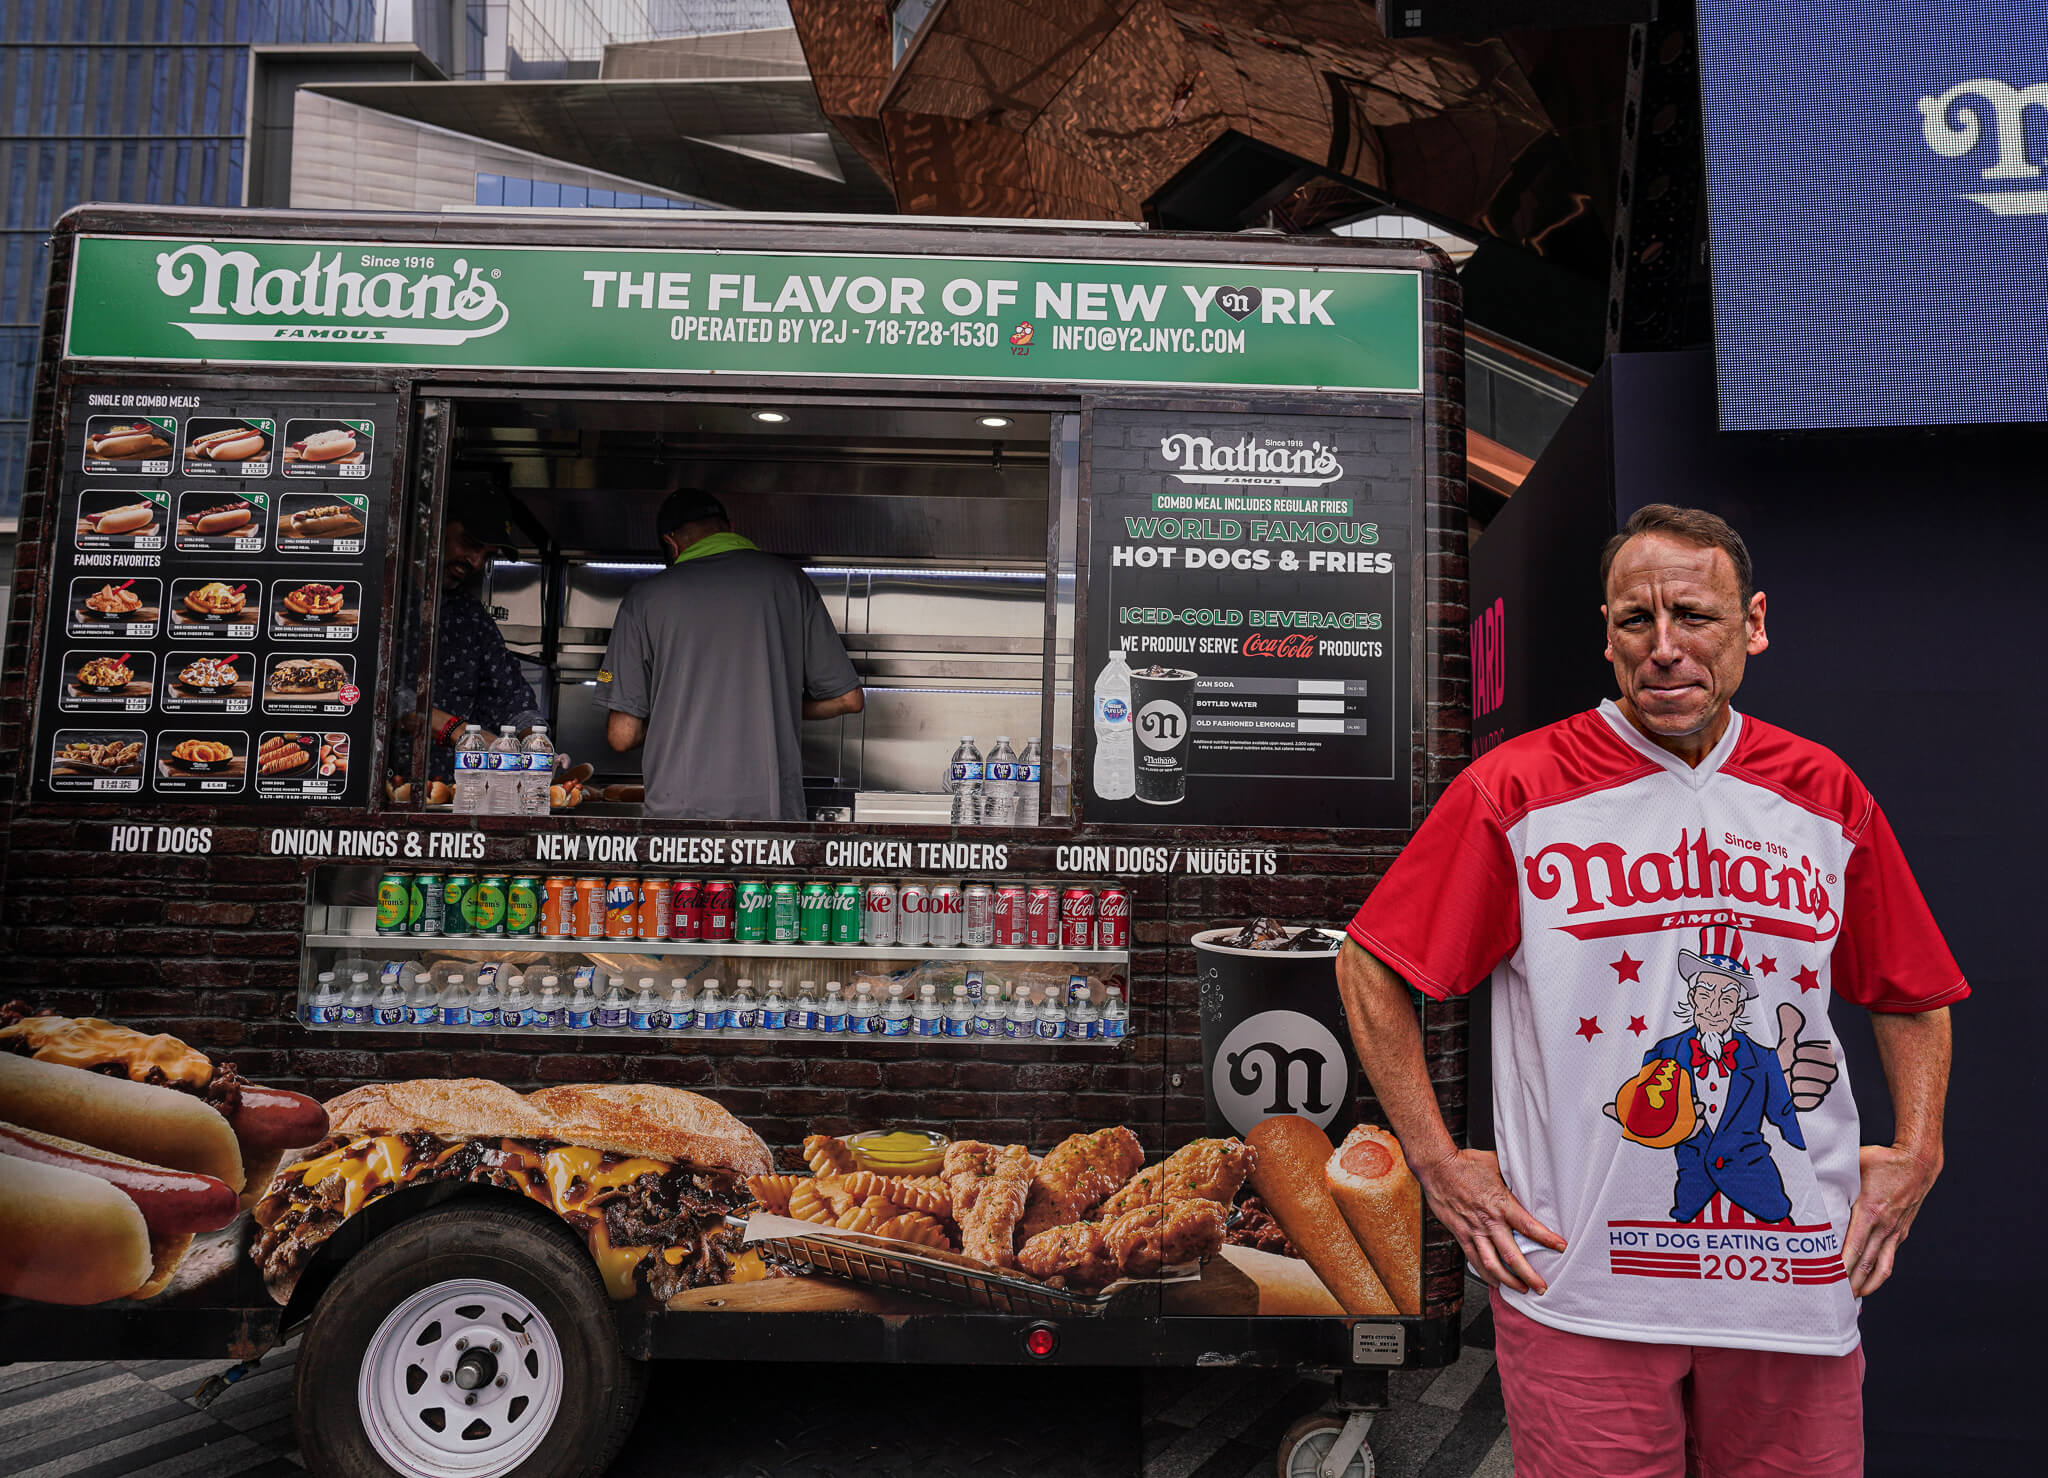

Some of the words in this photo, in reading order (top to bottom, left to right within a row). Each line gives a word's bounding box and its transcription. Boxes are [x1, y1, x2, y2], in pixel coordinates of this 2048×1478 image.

[361, 255, 400, 268] Since
[403, 256, 434, 269] 1916
[156, 244, 509, 322] Nathan's
[583, 270, 692, 310] THE
[707, 273, 926, 315] FLAVOR
[941, 278, 1019, 317] OF
[1035, 281, 1168, 322] NEW
[274, 328, 388, 341] FAMOUS
[670, 315, 773, 343] OPERATED
[778, 318, 804, 343] BY
[810, 319, 847, 344] Y2J
[865, 319, 999, 347] 718-728-1530
[1052, 325, 1246, 354] INFO@Y2JNYC.COM
[1011, 347, 1030, 356] Y2J
[88, 394, 120, 407] SINGLE
[121, 395, 133, 407] OR
[136, 396, 167, 408] COMBO
[169, 396, 200, 408] MEALS
[163, 419, 173, 428] #1
[260, 420, 270, 430] #2
[359, 422, 370, 431] #3
[1265, 439, 1285, 447] Since
[1286, 440, 1303, 448] 1916
[1161, 433, 1344, 477] Nathan's
[156, 493, 166, 503] #4
[254, 495, 264, 505] #5
[353, 496, 364, 506] #6
[1157, 495, 1193, 510] COMBO
[1195, 496, 1222, 511] MEAL
[1224, 497, 1272, 512] INCLUDES
[1273, 499, 1318, 513] REGULAR
[1320, 500, 1348, 514] FRIES
[1125, 517, 1242, 541] WORLD
[1250, 519, 1379, 544] FAMOUS
[74, 553, 110, 566] FAMOUS
[112, 554, 161, 567] FAVORITES
[1112, 546, 1177, 568] HOT
[1185, 547, 1271, 571] DOGS
[1278, 549, 1299, 571] &
[1309, 550, 1393, 574] FRIES
[1120, 607, 1243, 626] ICED-COLD
[1249, 610, 1383, 630] BEVERAGES
[1120, 636, 1138, 651] WE
[1141, 637, 1197, 652] PRODULY
[1199, 638, 1239, 654] SERVE
[1319, 640, 1383, 657] PRODUCTS
[1196, 700, 1229, 708] BOTTLED
[1231, 701, 1258, 709] WATER
[1196, 720, 1211, 728] OLD
[1212, 721, 1254, 729] FASHIONED
[1255, 721, 1296, 729] LEMONADE
[111, 826, 153, 852] HOT
[156, 827, 212, 853] DOGS
[271, 829, 332, 855] ONION
[337, 830, 398, 857] RINGS
[404, 832, 424, 857] &
[428, 833, 485, 859] FRIES
[1725, 832, 1762, 851] Since
[1765, 840, 1789, 859] 1916
[536, 835, 581, 861] NEW
[585, 836, 638, 862] YORK
[649, 838, 725, 864] CHEESE
[731, 839, 796, 866] STEAK
[825, 841, 914, 868] CHICKEN
[918, 843, 1008, 870] TENDERS
[1056, 845, 1110, 872] CORN
[1186, 849, 1277, 875] NUGGETS
[1524, 827, 1840, 930] Nathan's
[1610, 1231, 1649, 1247] HOT
[1656, 1233, 1700, 1249] DOG
[1707, 1234, 1780, 1251] EATING
[1703, 1254, 1791, 1284] 2023
